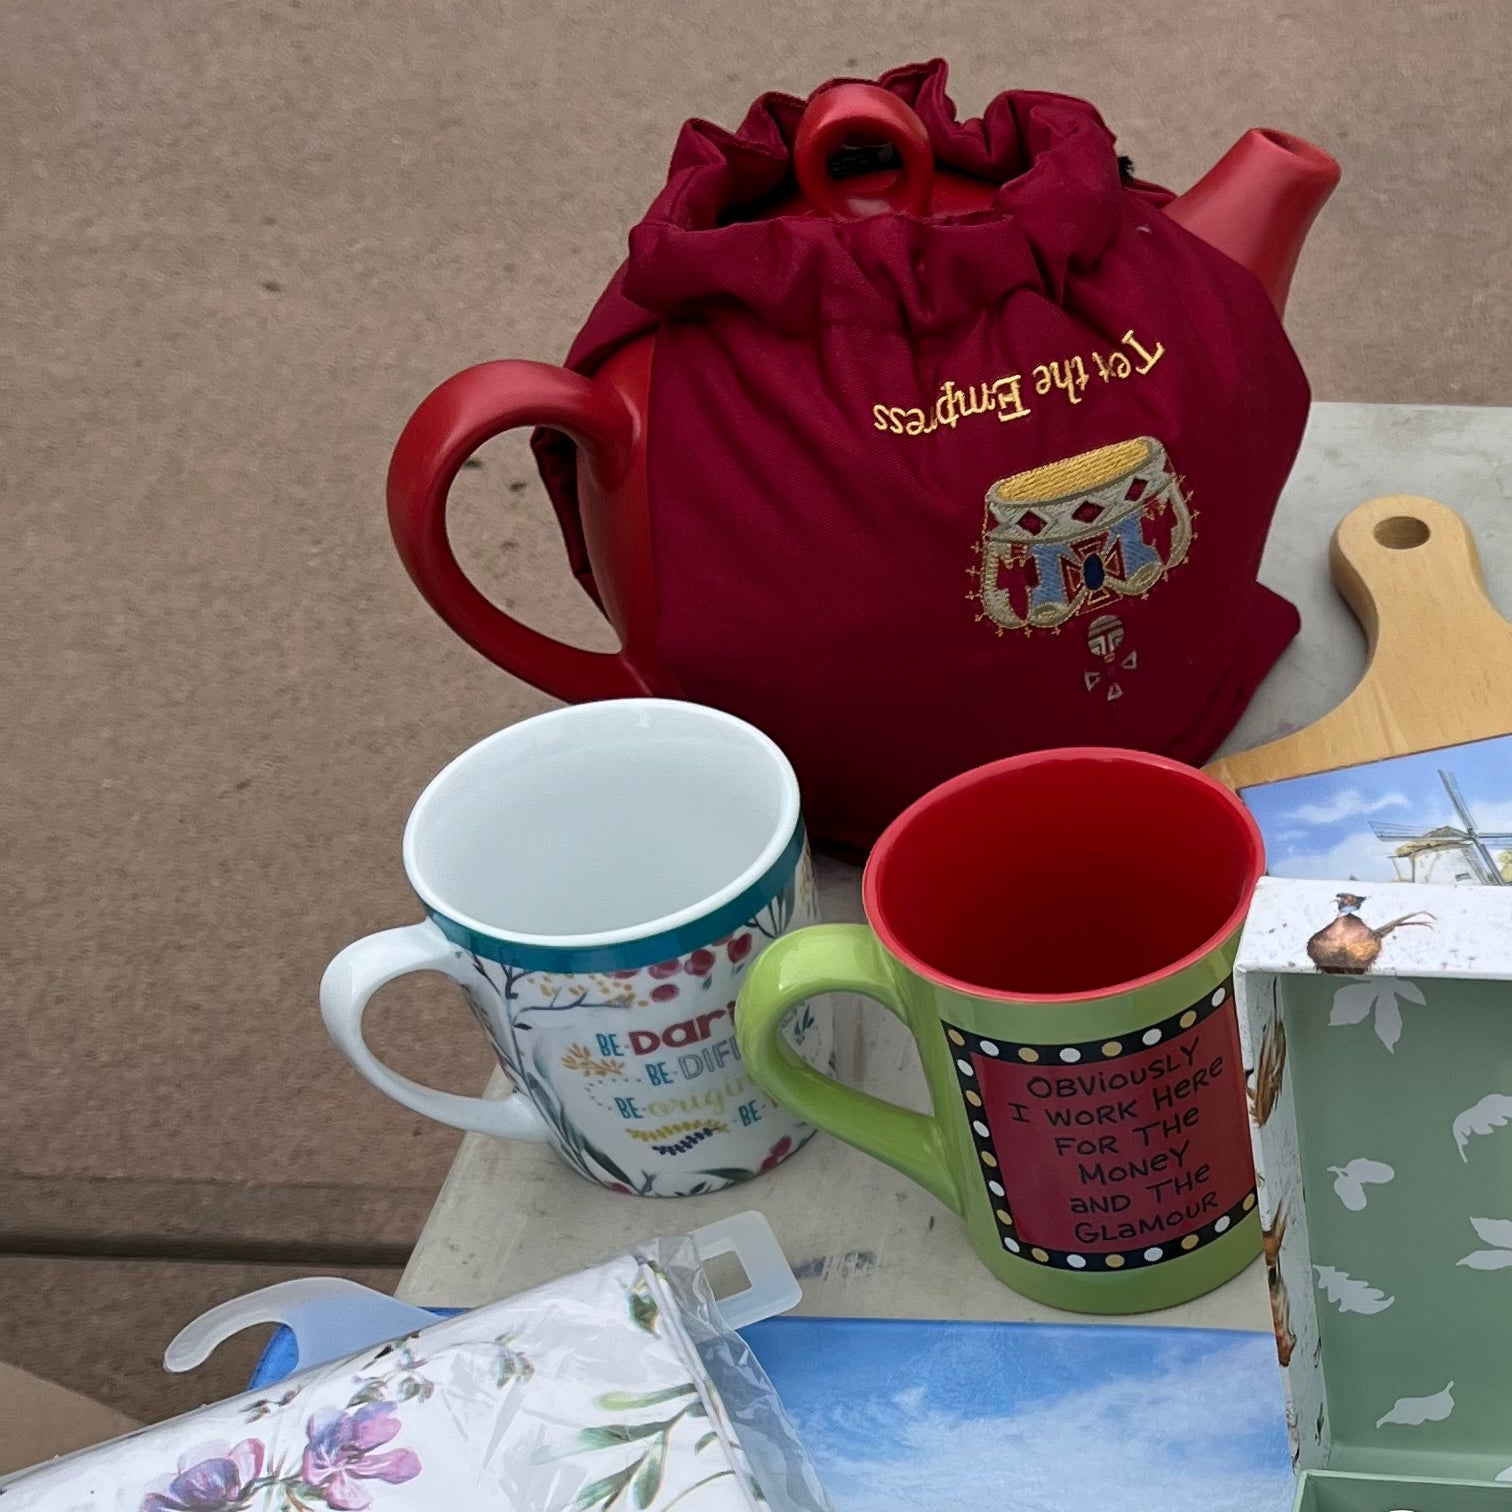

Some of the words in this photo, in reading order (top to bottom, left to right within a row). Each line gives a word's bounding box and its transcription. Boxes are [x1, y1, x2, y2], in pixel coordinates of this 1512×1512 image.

[1031, 355, 1090, 404] the
[872, 375, 1031, 436] Empress
[1008, 1102, 1031, 1124] I
[1046, 1099, 1138, 1127] WORK
[1055, 1135, 1119, 1156] FOR
